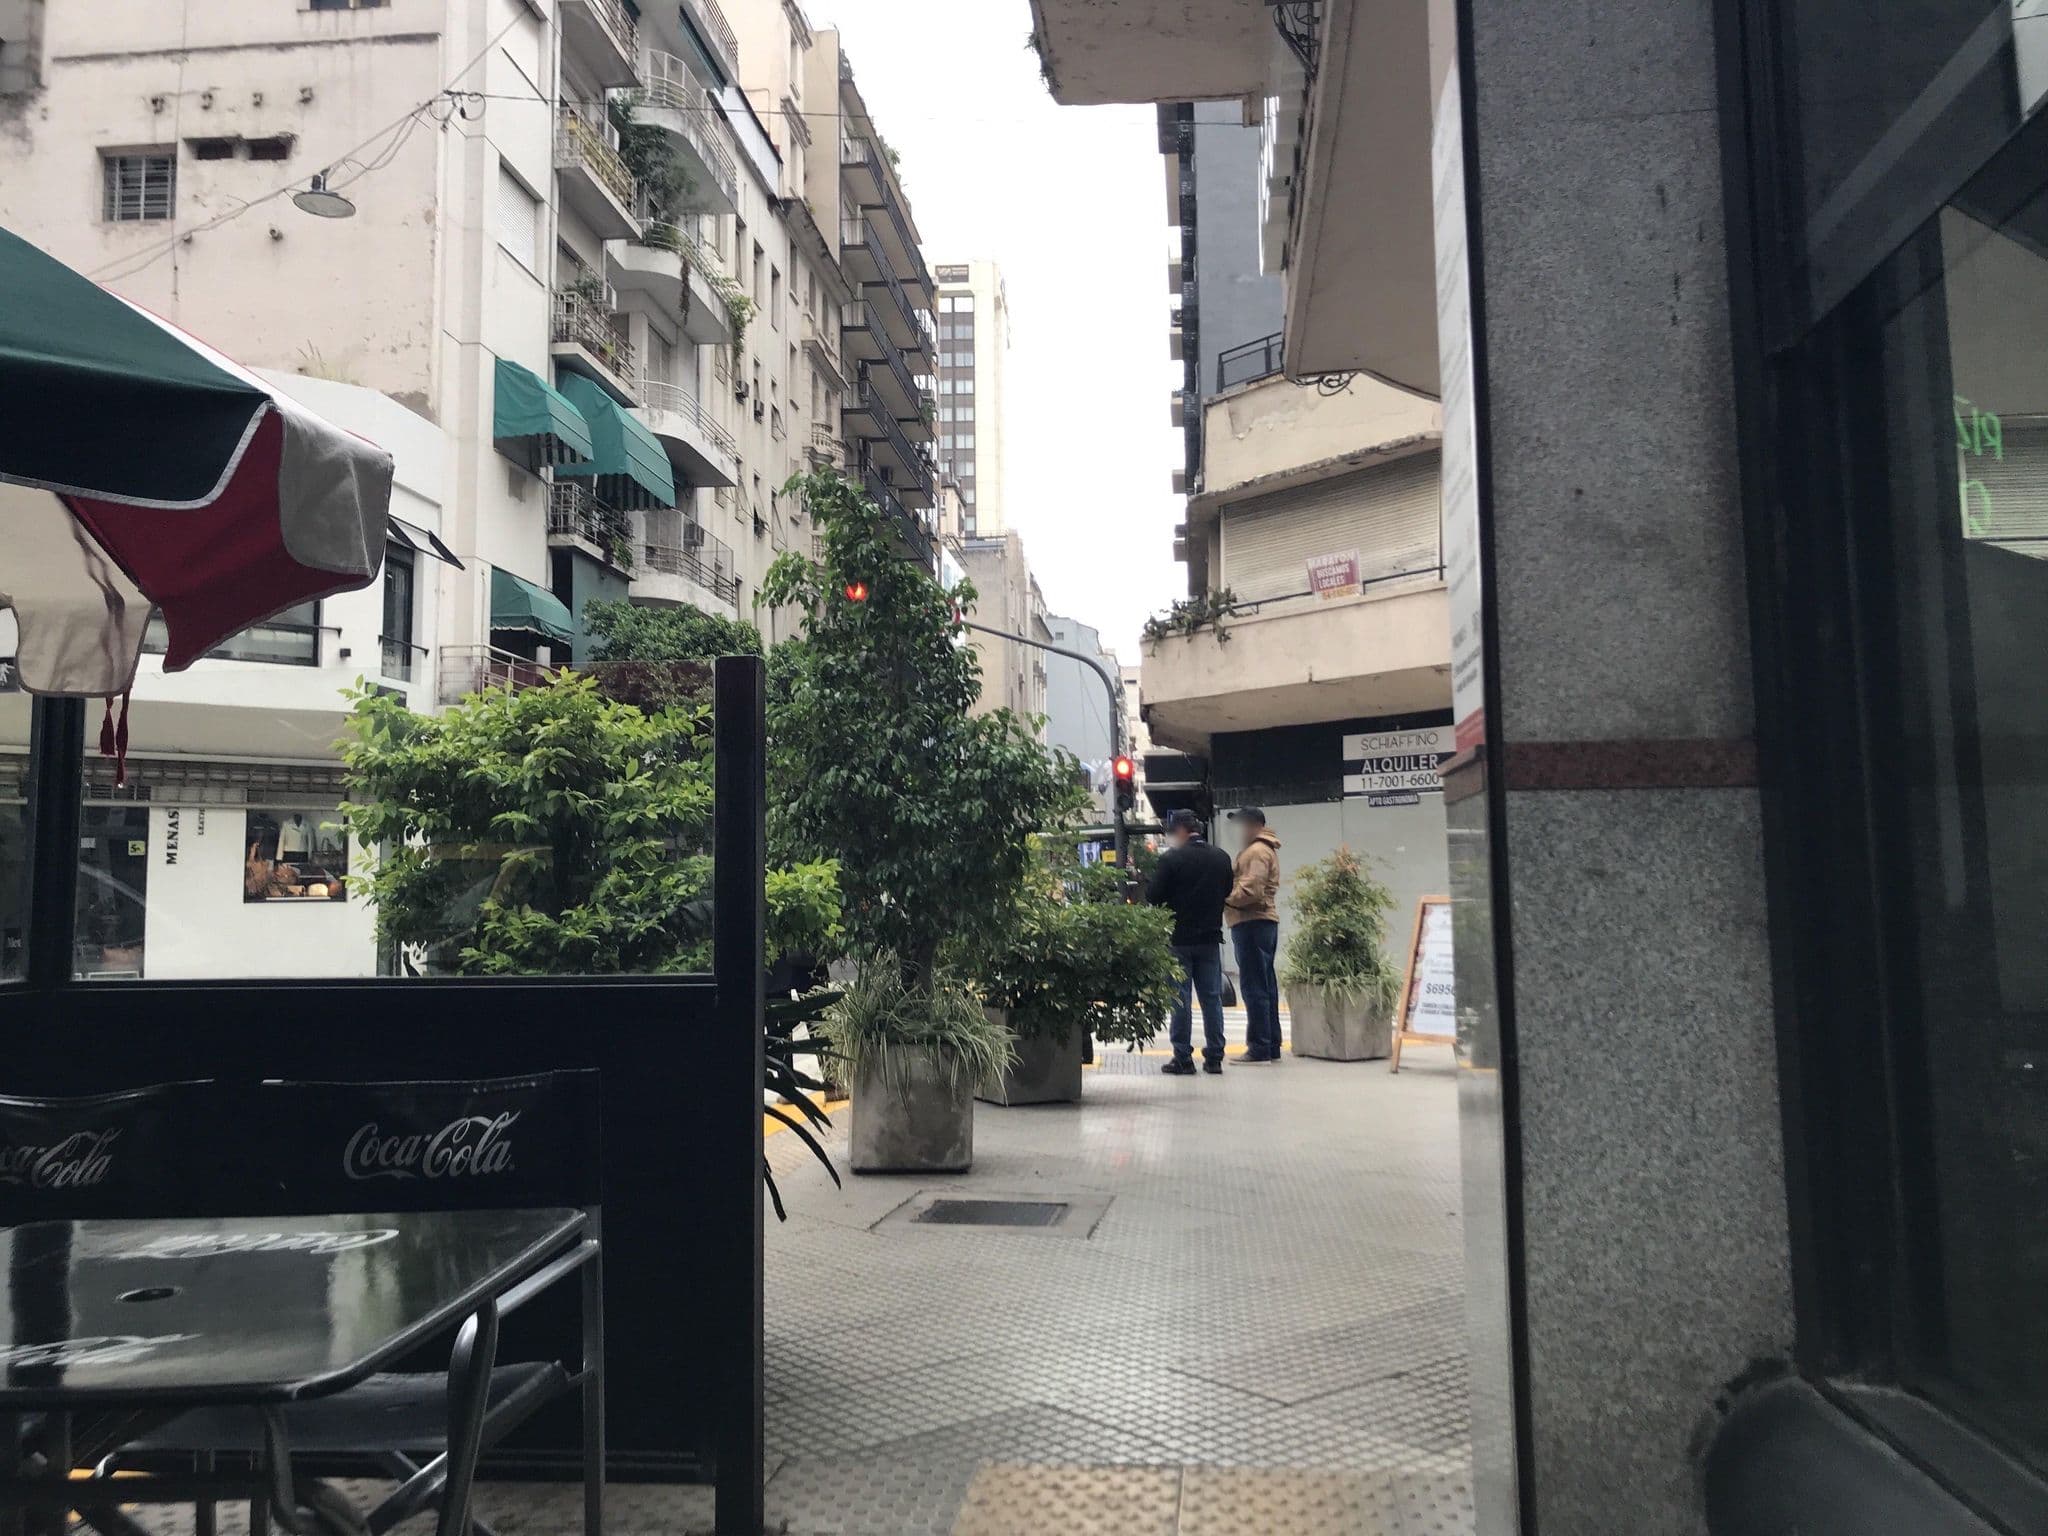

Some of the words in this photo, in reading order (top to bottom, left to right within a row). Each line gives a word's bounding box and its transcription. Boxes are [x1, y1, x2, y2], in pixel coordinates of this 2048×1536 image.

[1360, 732, 1439, 751] SCHIAFFINO
[1361, 754, 1440, 774] ALQUILER
[1361, 772, 1440, 790] 11-7001-6600
[343, 1109, 521, 1180] Coca-Cola
